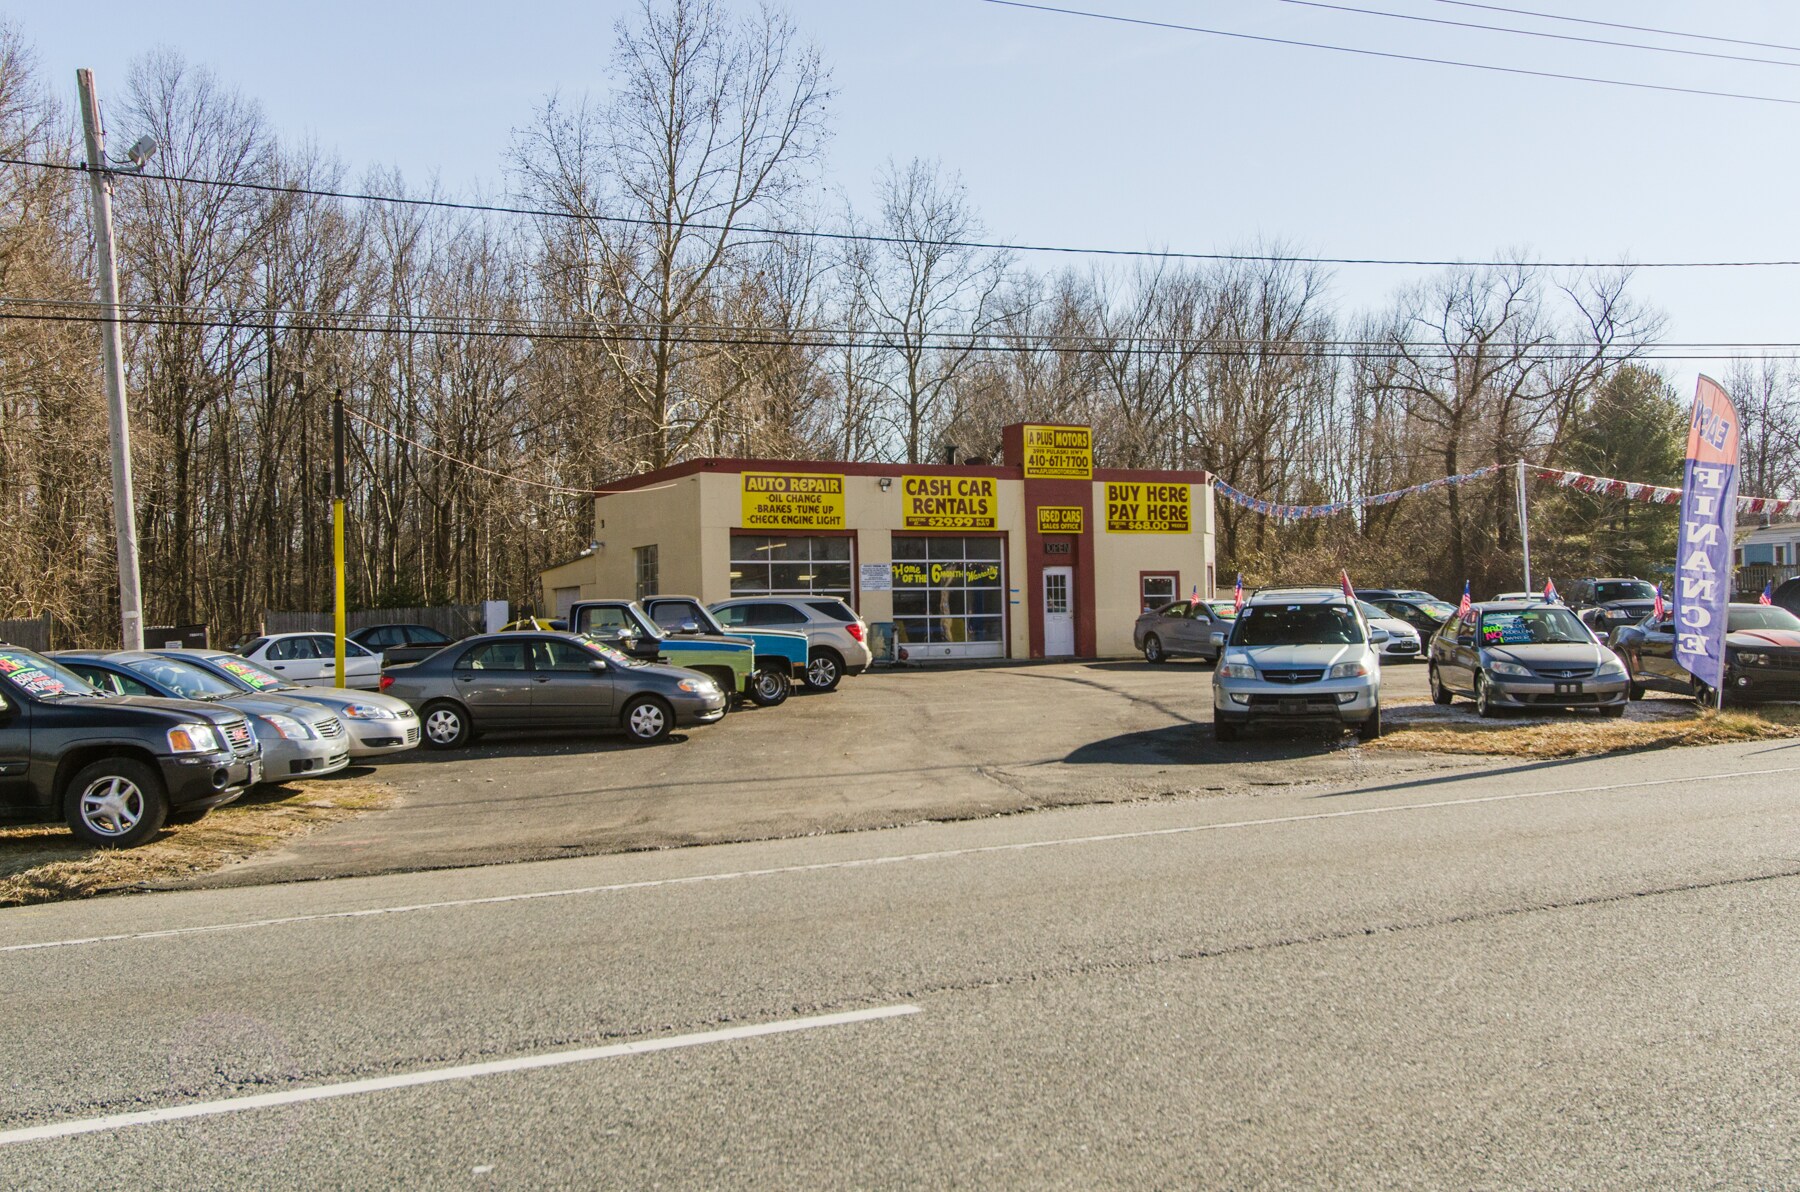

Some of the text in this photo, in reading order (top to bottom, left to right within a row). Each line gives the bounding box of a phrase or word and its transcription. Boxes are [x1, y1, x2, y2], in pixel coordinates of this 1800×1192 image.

[1028, 431, 1088, 447] A PLUS MOTORS
[1028, 454, 1088, 468] 410-671-7700
[747, 477, 840, 493] AUTO REPAIR
[905, 478, 993, 497] CASH CAR
[786, 494, 822, 503] CHANGE
[1108, 485, 1188, 503] BUY HERE
[822, 506, 834, 514] UP
[913, 497, 988, 516] RENTALS
[1108, 503, 1188, 521] PAY HERE
[781, 515, 814, 525] ENGINE
[816, 516, 841, 525] LIGHT
[928, 517, 974, 527] $29.99
[1040, 510, 1081, 523] USED CARS
[1042, 522, 1079, 530] SALES OFFICE
[1127, 521, 1170, 530] $68.00
[1046, 543, 1070, 553] OPEN
[892, 563, 921, 579] Home
[931, 563, 942, 583] 6
[940, 570, 964, 578] MONTH
[902, 574, 927, 583] OF THE
[1482, 625, 1502, 634] BAD
[1485, 632, 1502, 640] NO
